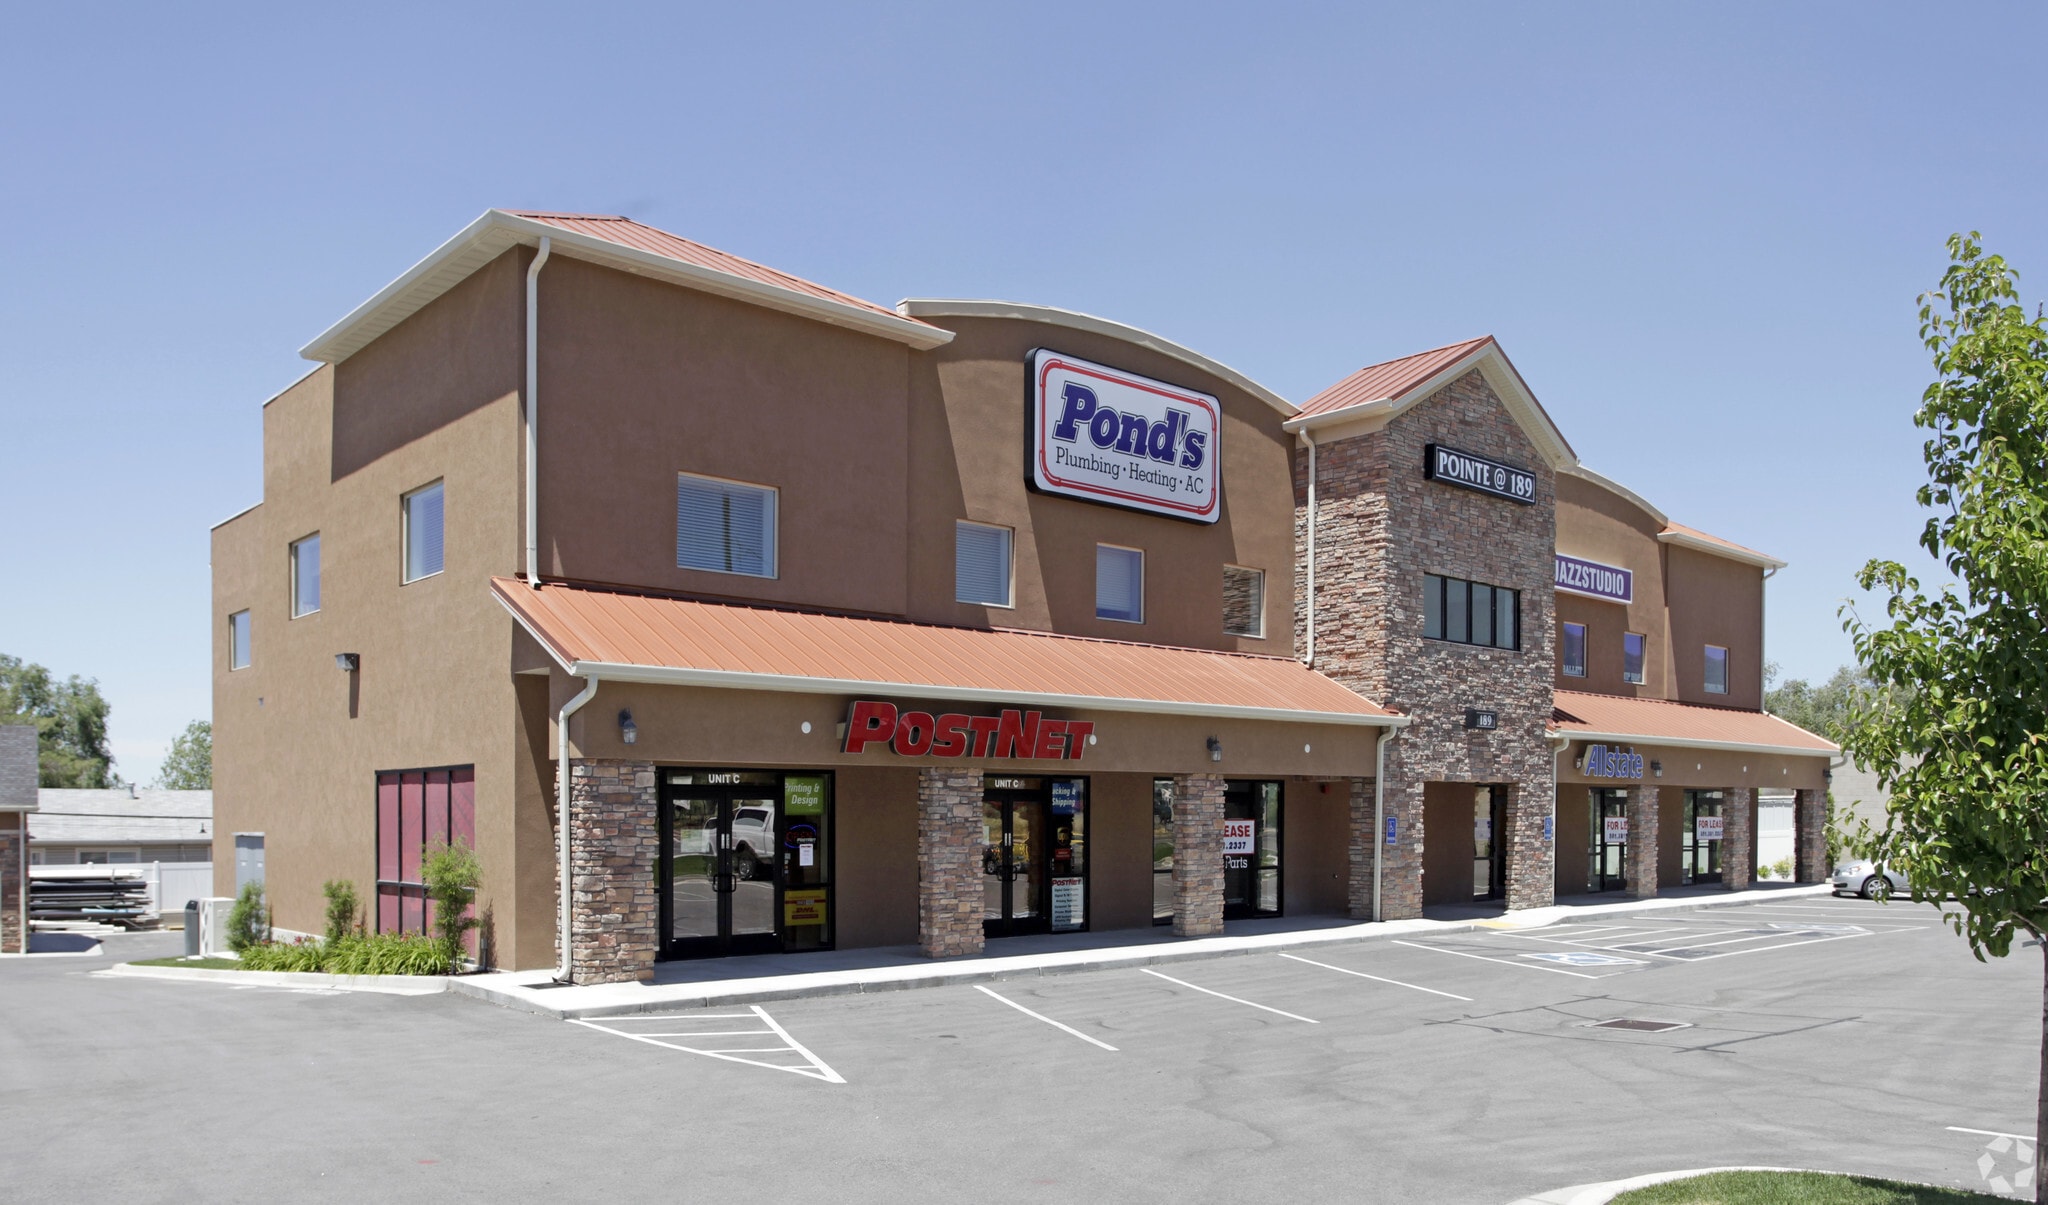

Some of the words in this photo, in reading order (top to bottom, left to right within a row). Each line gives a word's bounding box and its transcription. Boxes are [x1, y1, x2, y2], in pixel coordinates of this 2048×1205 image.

[1052, 381, 1207, 471] Pond's
[1056, 446, 1120, 480] Plumbing
[1129, 463, 1177, 492] Heating
[1185, 476, 1204, 494] AC
[1439, 451, 1491, 486] POINTE
[1494, 468, 1506, 490] @
[1511, 474, 1533, 497] 189
[1555, 559, 1624, 596] JAZZSTUDIO
[1479, 714, 1492, 726] 189
[845, 701, 1095, 760] POSTNET
[1584, 744, 1644, 779] Allstate
[708, 774, 731, 784] UNIT
[732, 774, 741, 784] C
[994, 779, 1012, 788] UNIT
[1012, 779, 1019, 788] C
[791, 795, 818, 806] Design
[1223, 825, 1250, 837] EASE
[1607, 821, 1619, 830] FOR
[1224, 855, 1248, 869] Parts
